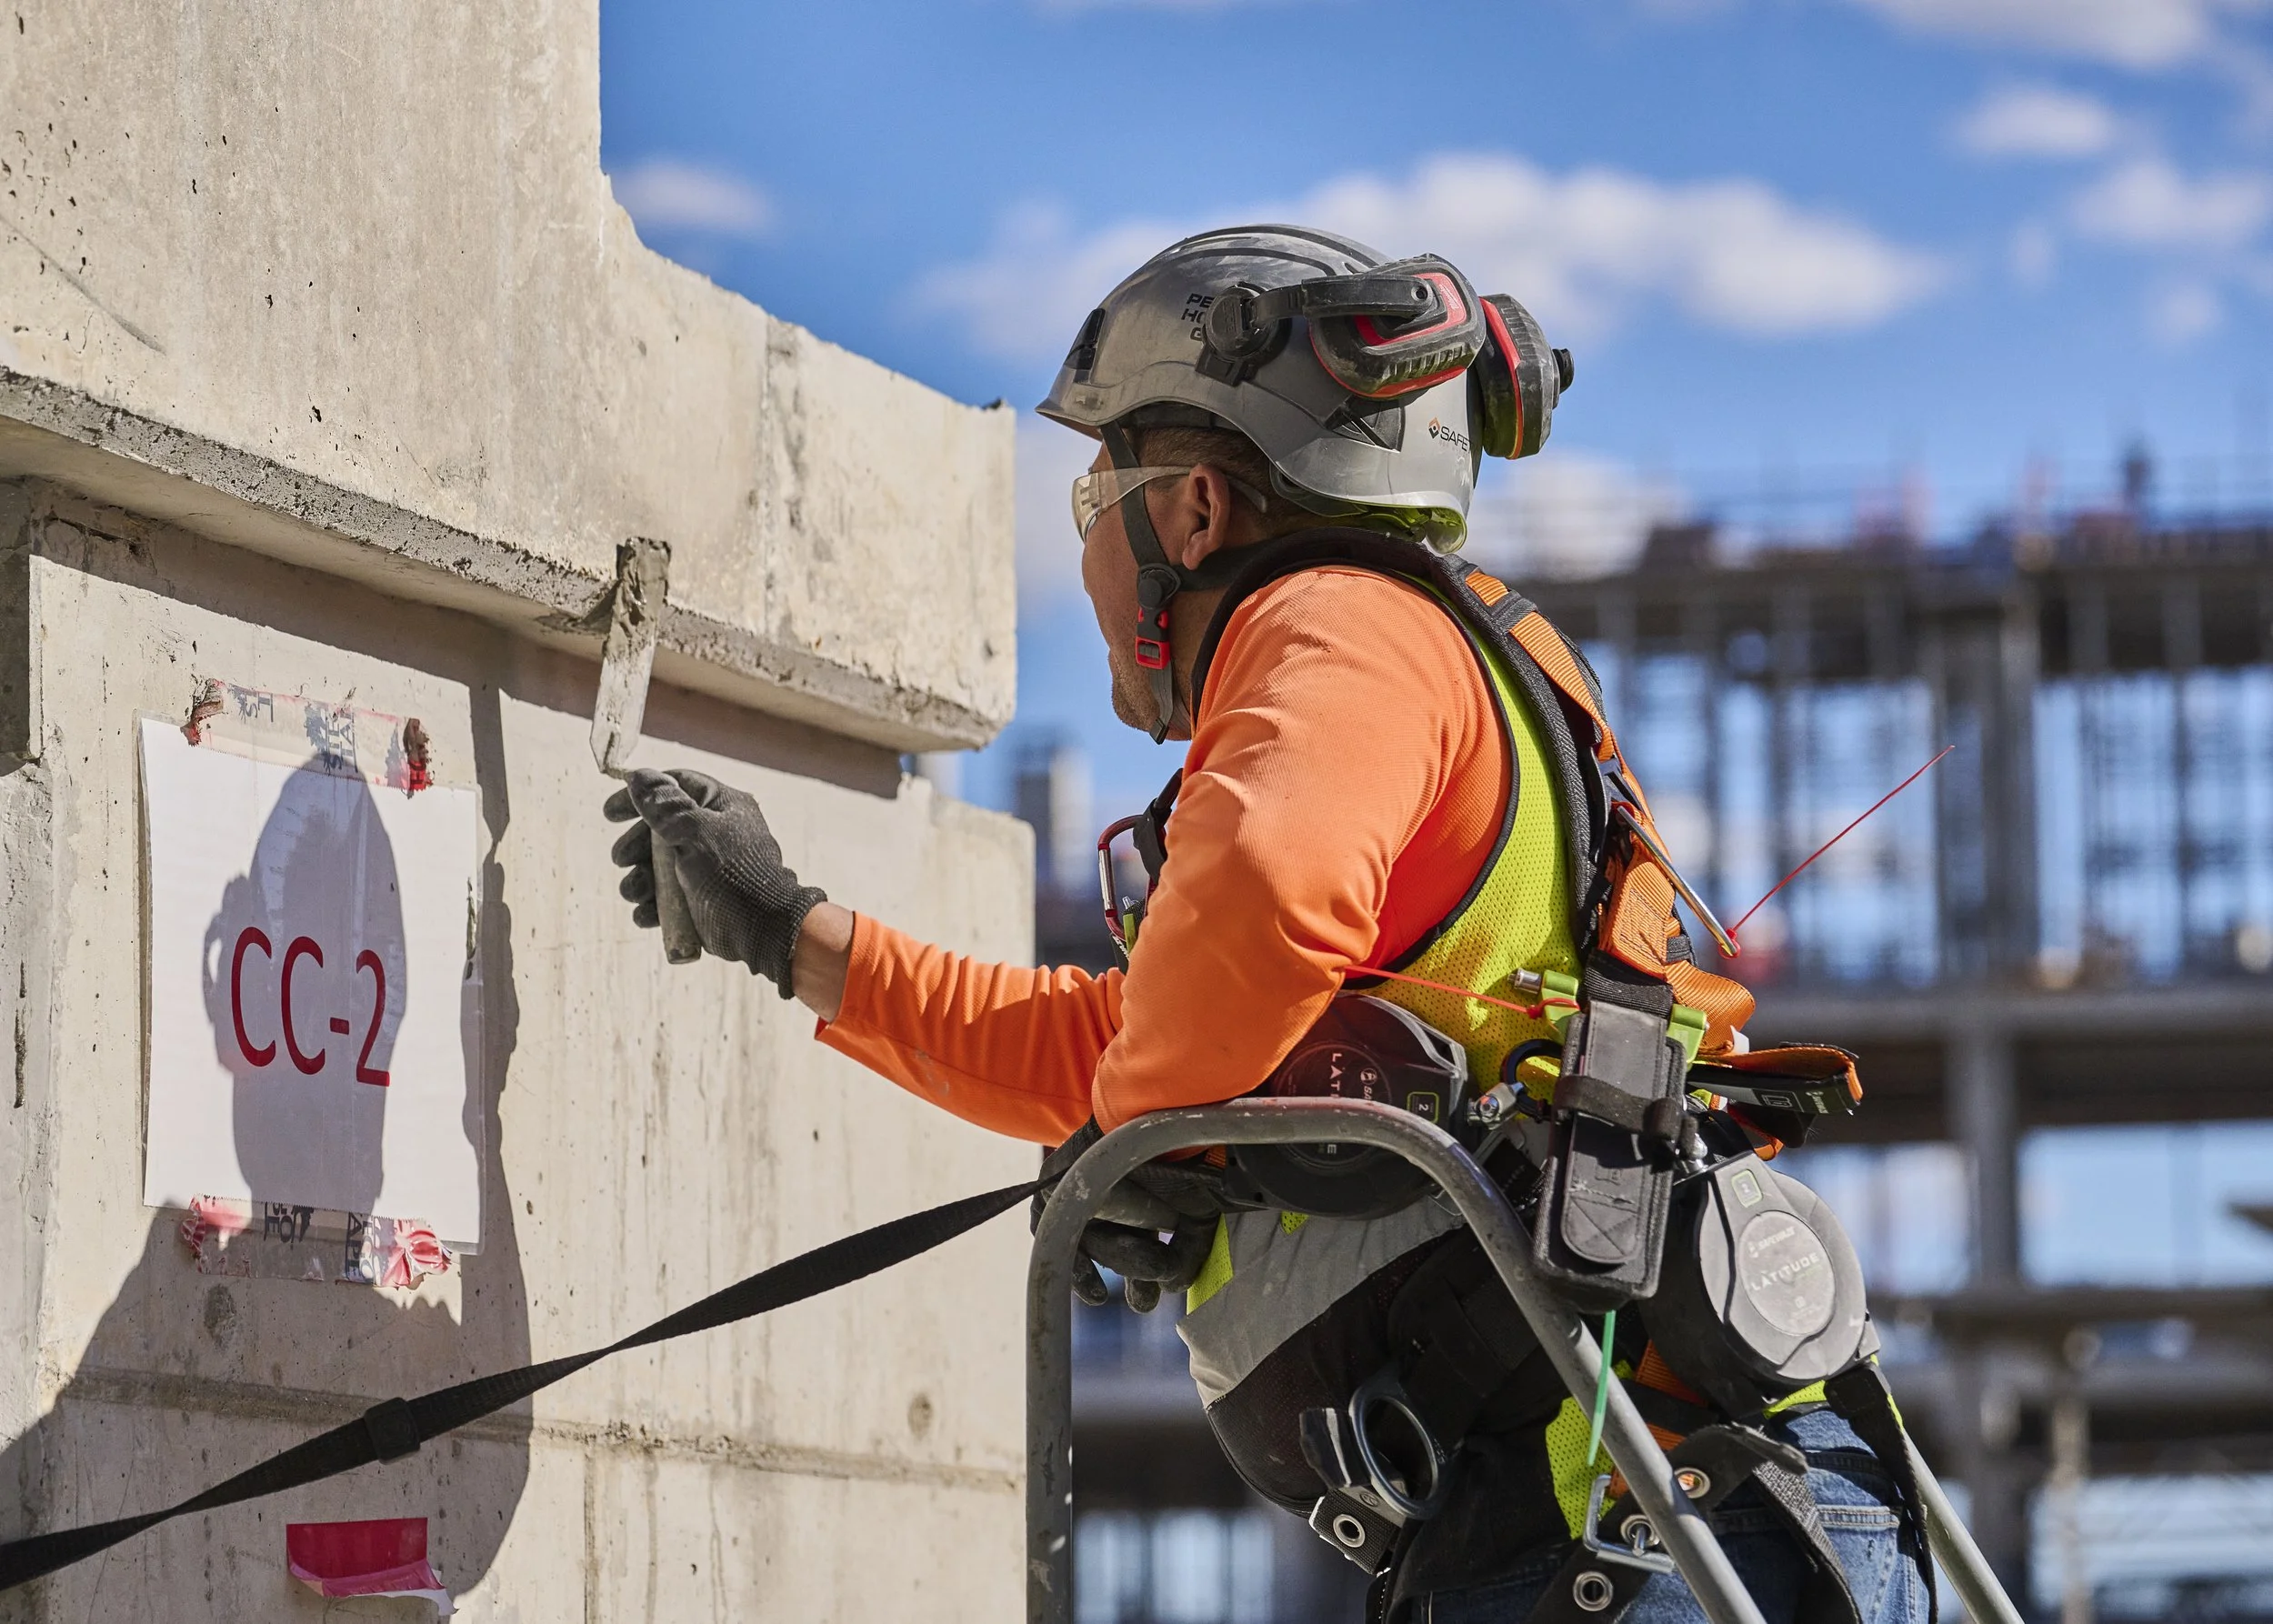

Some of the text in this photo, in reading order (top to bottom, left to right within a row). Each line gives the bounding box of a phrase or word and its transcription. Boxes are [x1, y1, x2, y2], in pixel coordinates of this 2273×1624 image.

[1440, 426, 1470, 453] SAFE
[231, 927, 390, 1087] CC-2
[1418, 1103, 1429, 1112] 2
[1751, 1252, 1819, 1291] LATITUDE
